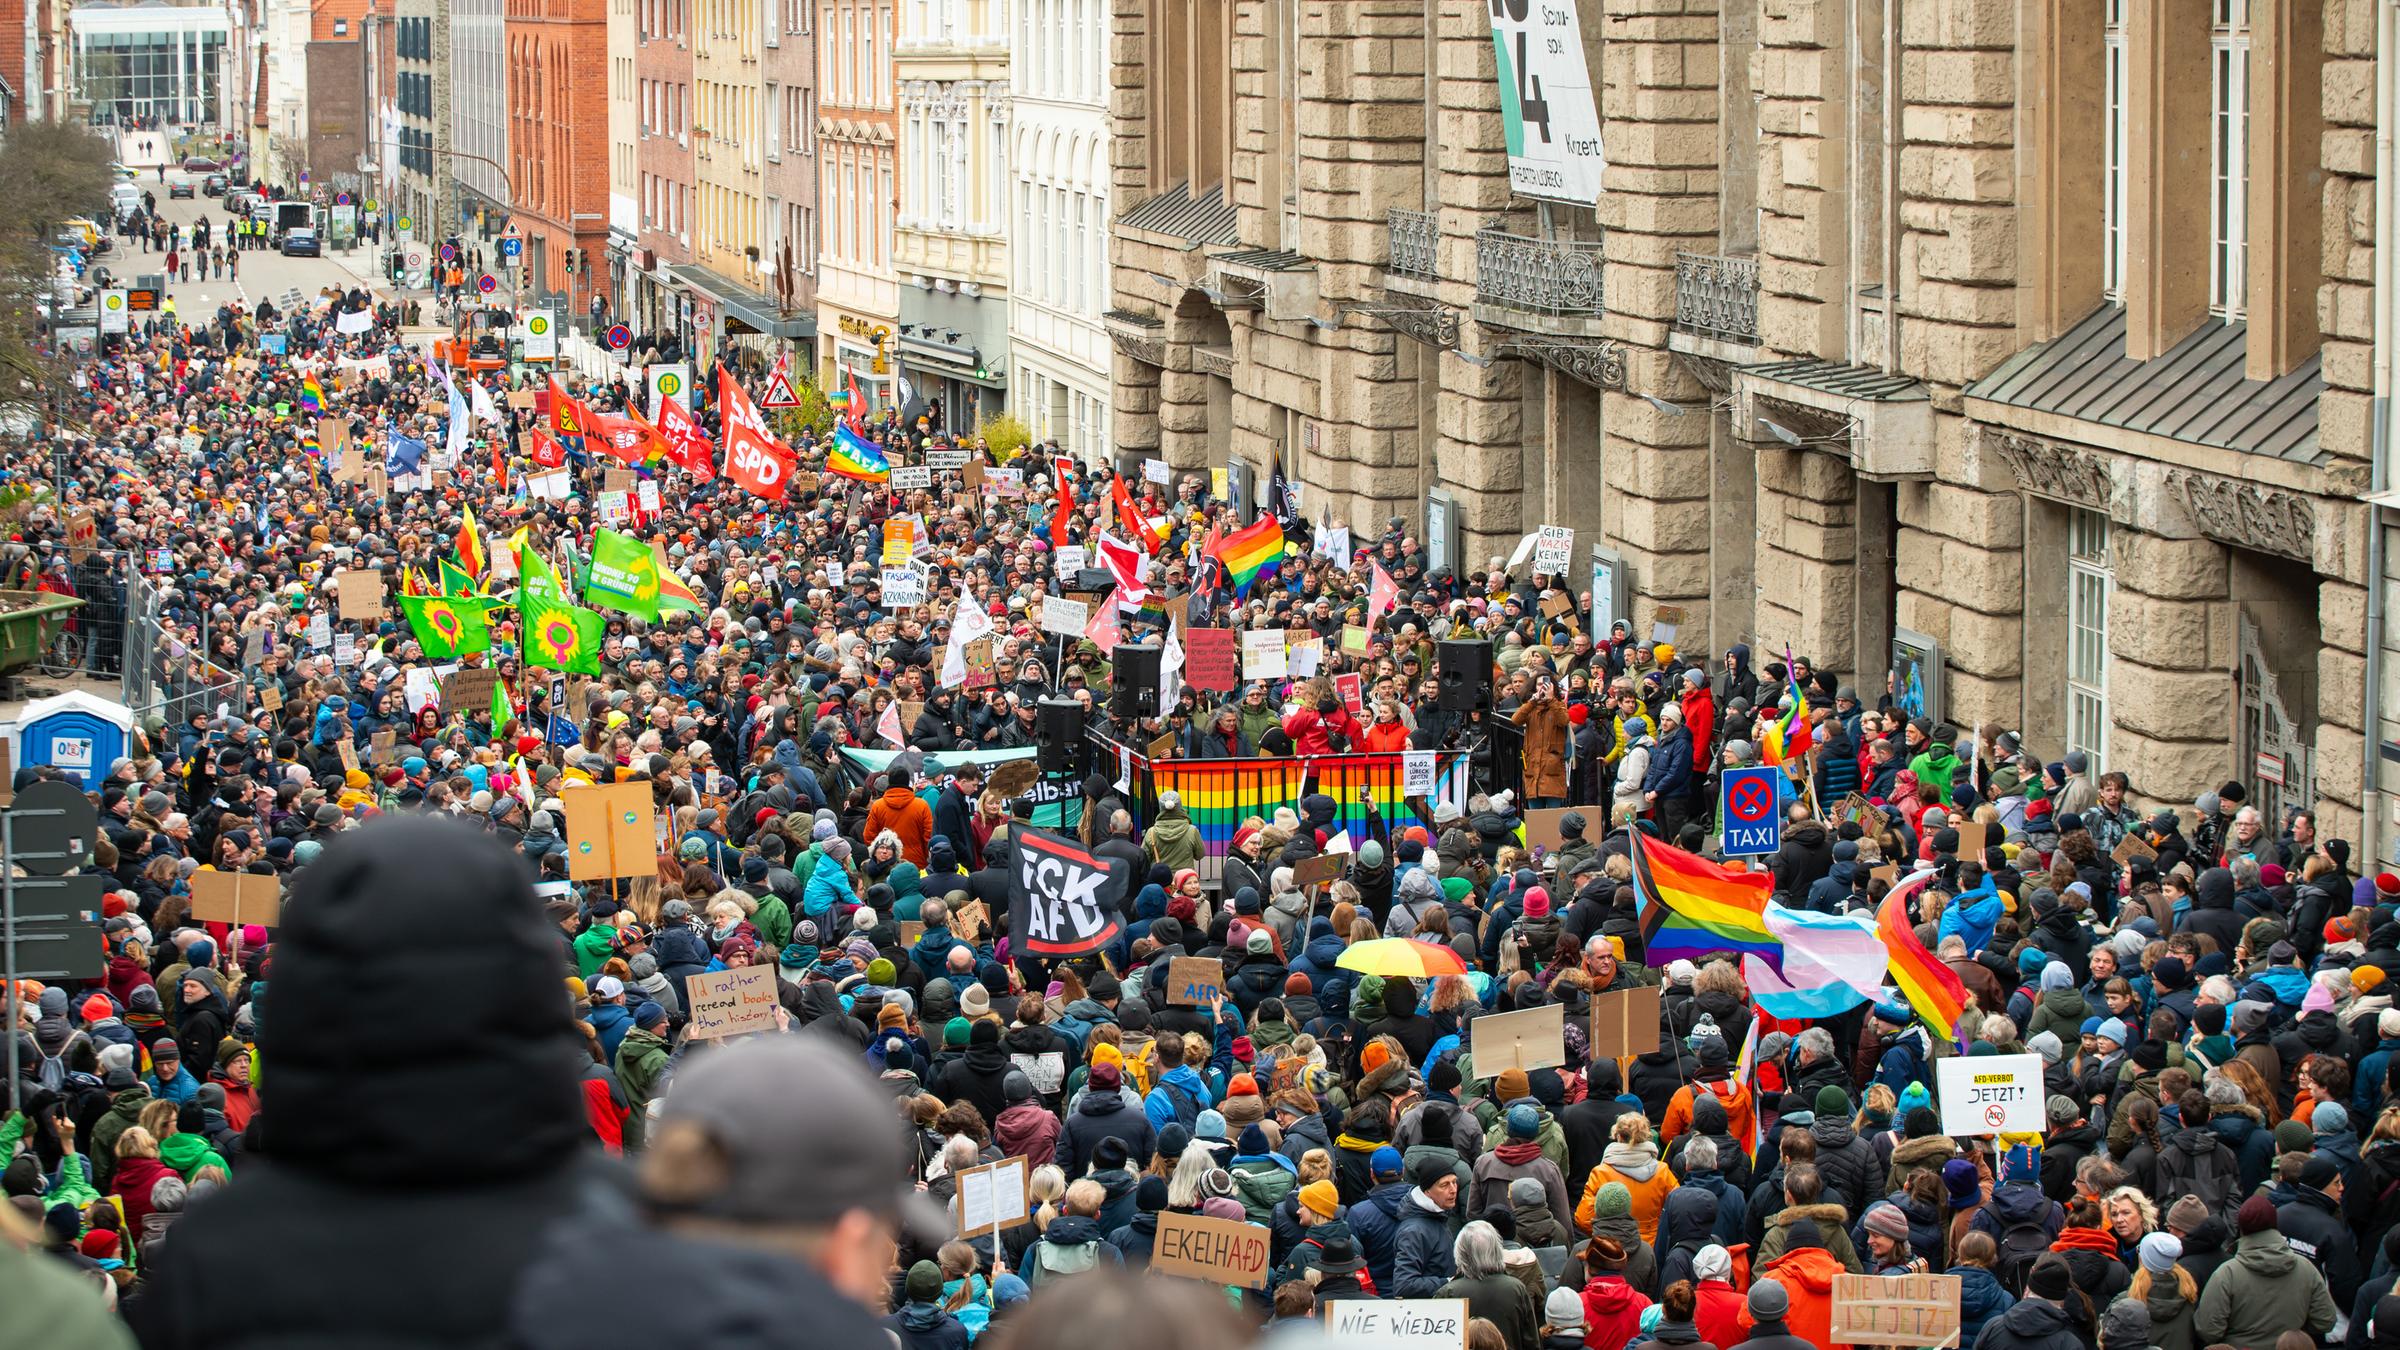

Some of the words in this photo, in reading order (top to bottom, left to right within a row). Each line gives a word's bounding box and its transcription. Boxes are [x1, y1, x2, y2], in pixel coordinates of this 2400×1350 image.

[664, 378, 674, 391] H
[734, 440, 780, 485] SPD
[1544, 528, 1564, 539] GIB
[1540, 539, 1570, 551] NAZIS
[1538, 550, 1566, 560] KEINE
[909, 561, 925, 576] OMAS
[1534, 561, 1569, 576] CHANCE
[627, 573, 640, 585] 90
[885, 572, 916, 581] FASCHOS
[601, 577, 636, 595] GRÜNEN
[882, 591, 917, 604] AZKABAN
[1285, 631, 1309, 640] MAKE
[1409, 767, 1429, 775] LÜBECK
[1730, 827, 1774, 846] TAXI
[1021, 847, 1109, 906] FCK
[1028, 893, 1106, 942] AFD
[715, 974, 762, 994] rather
[1184, 982, 1217, 1001] AfD
[695, 997, 737, 1013] reread
[743, 992, 774, 1005] books
[698, 1015, 724, 1030] than
[1974, 1073, 2014, 1083] AFD-VERBOT
[1162, 1228, 1265, 1273] EKELHAfD
[1839, 1275, 1873, 1301] NIE
[1883, 1278, 1951, 1302] WIEDER
[1339, 1308, 1379, 1337] NIE
[1390, 1310, 1457, 1338] WIEDER
[1847, 1304, 1879, 1331] IST
[1886, 1305, 1954, 1337] JETZT
